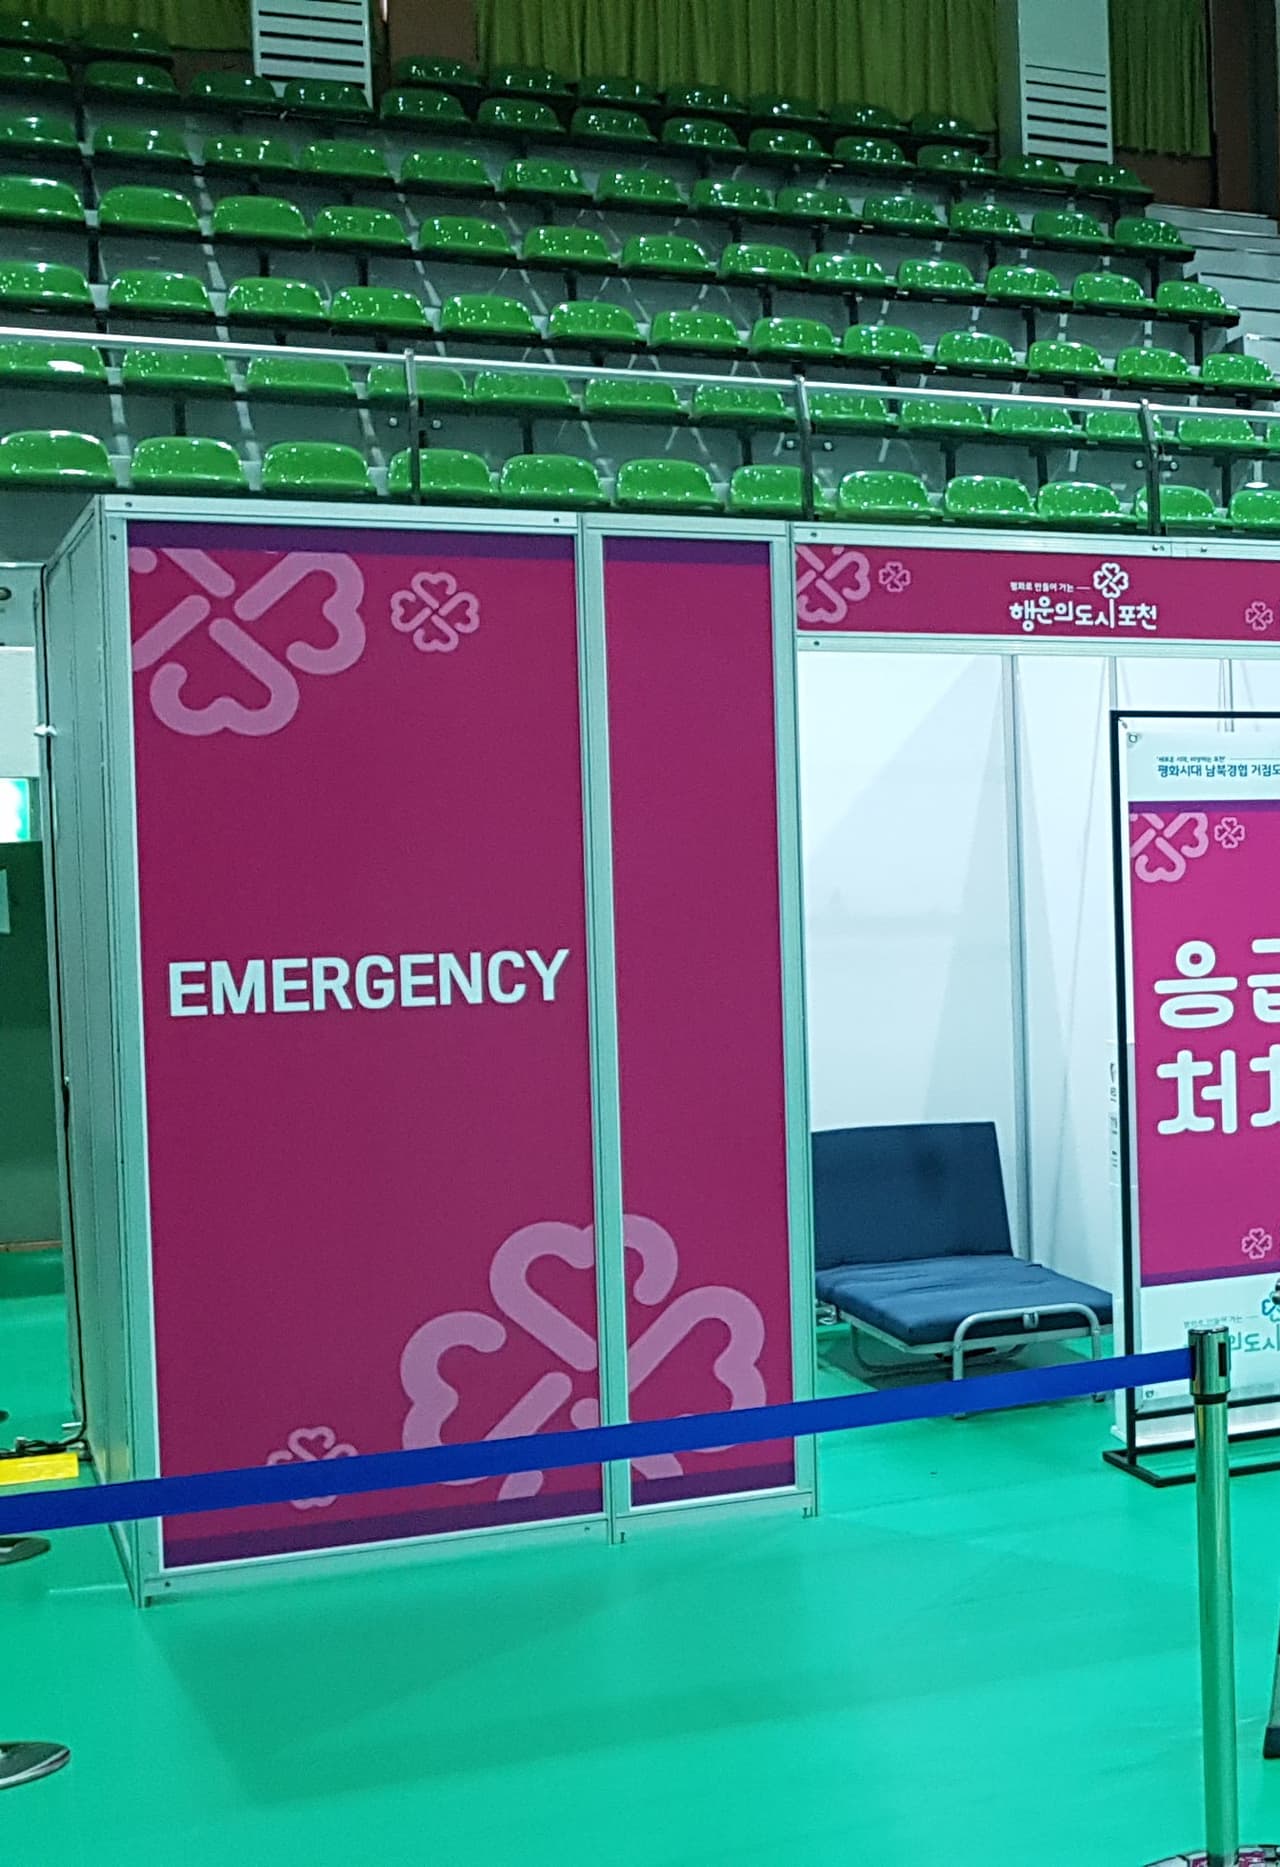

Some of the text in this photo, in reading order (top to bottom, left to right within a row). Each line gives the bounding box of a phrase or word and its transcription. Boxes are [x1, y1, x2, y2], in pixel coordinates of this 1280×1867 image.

[1157, 764, 1202, 777] 평화시대
[1205, 764, 1248, 777] 남북경협
[168, 948, 570, 1018] EMERGENCY
